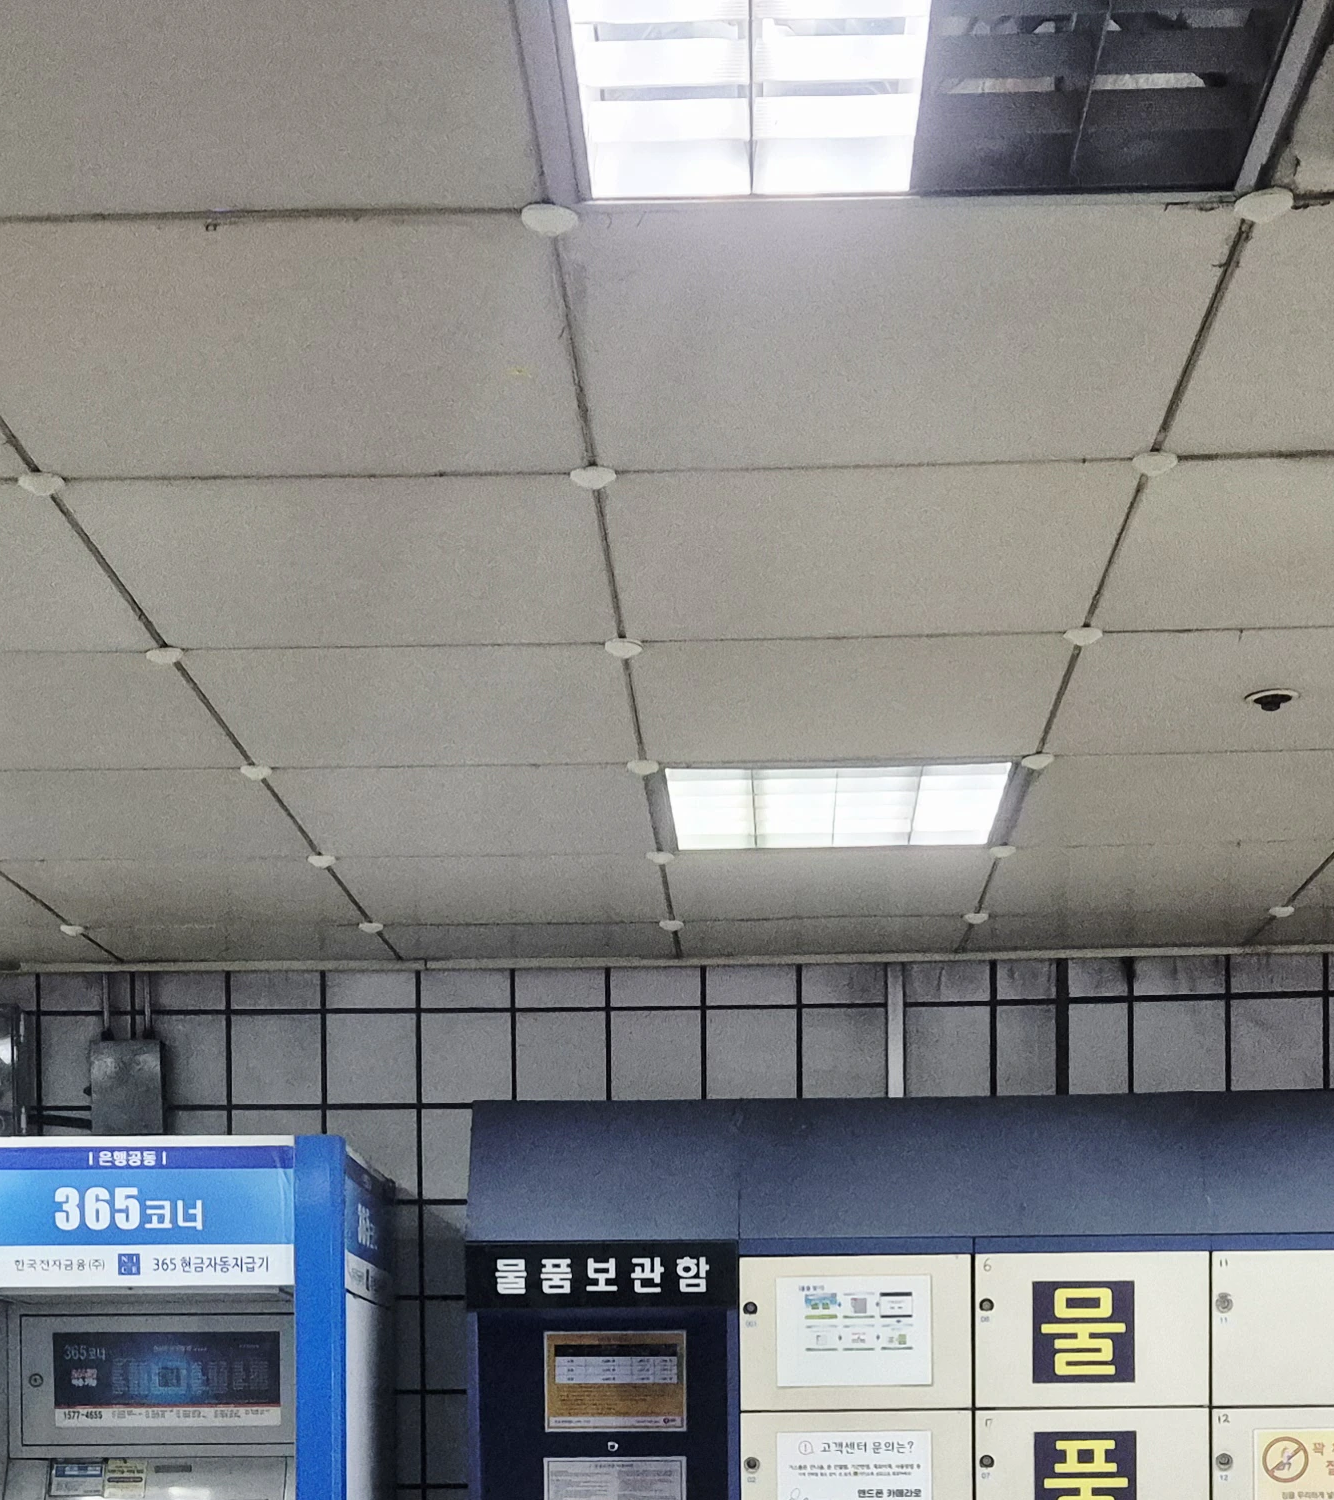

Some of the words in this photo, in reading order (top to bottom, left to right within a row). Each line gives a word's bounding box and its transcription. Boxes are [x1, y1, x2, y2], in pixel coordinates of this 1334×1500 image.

[98, 1151, 157, 1167] 은행공동
[54, 1187, 203, 1230] 365코너
[14, 1259, 105, 1271] 한국전자금융(주)
[152, 1257, 177, 1272] 365
[180, 1256, 269, 1274] 현금자동지급기
[983, 1258, 992, 1272] 6
[495, 1256, 709, 1294] 물품보관함
[1217, 1414, 1230, 1424] 12
[820, 1441, 867, 1455] 고객센터
[871, 1440, 915, 1455] 문의는?
